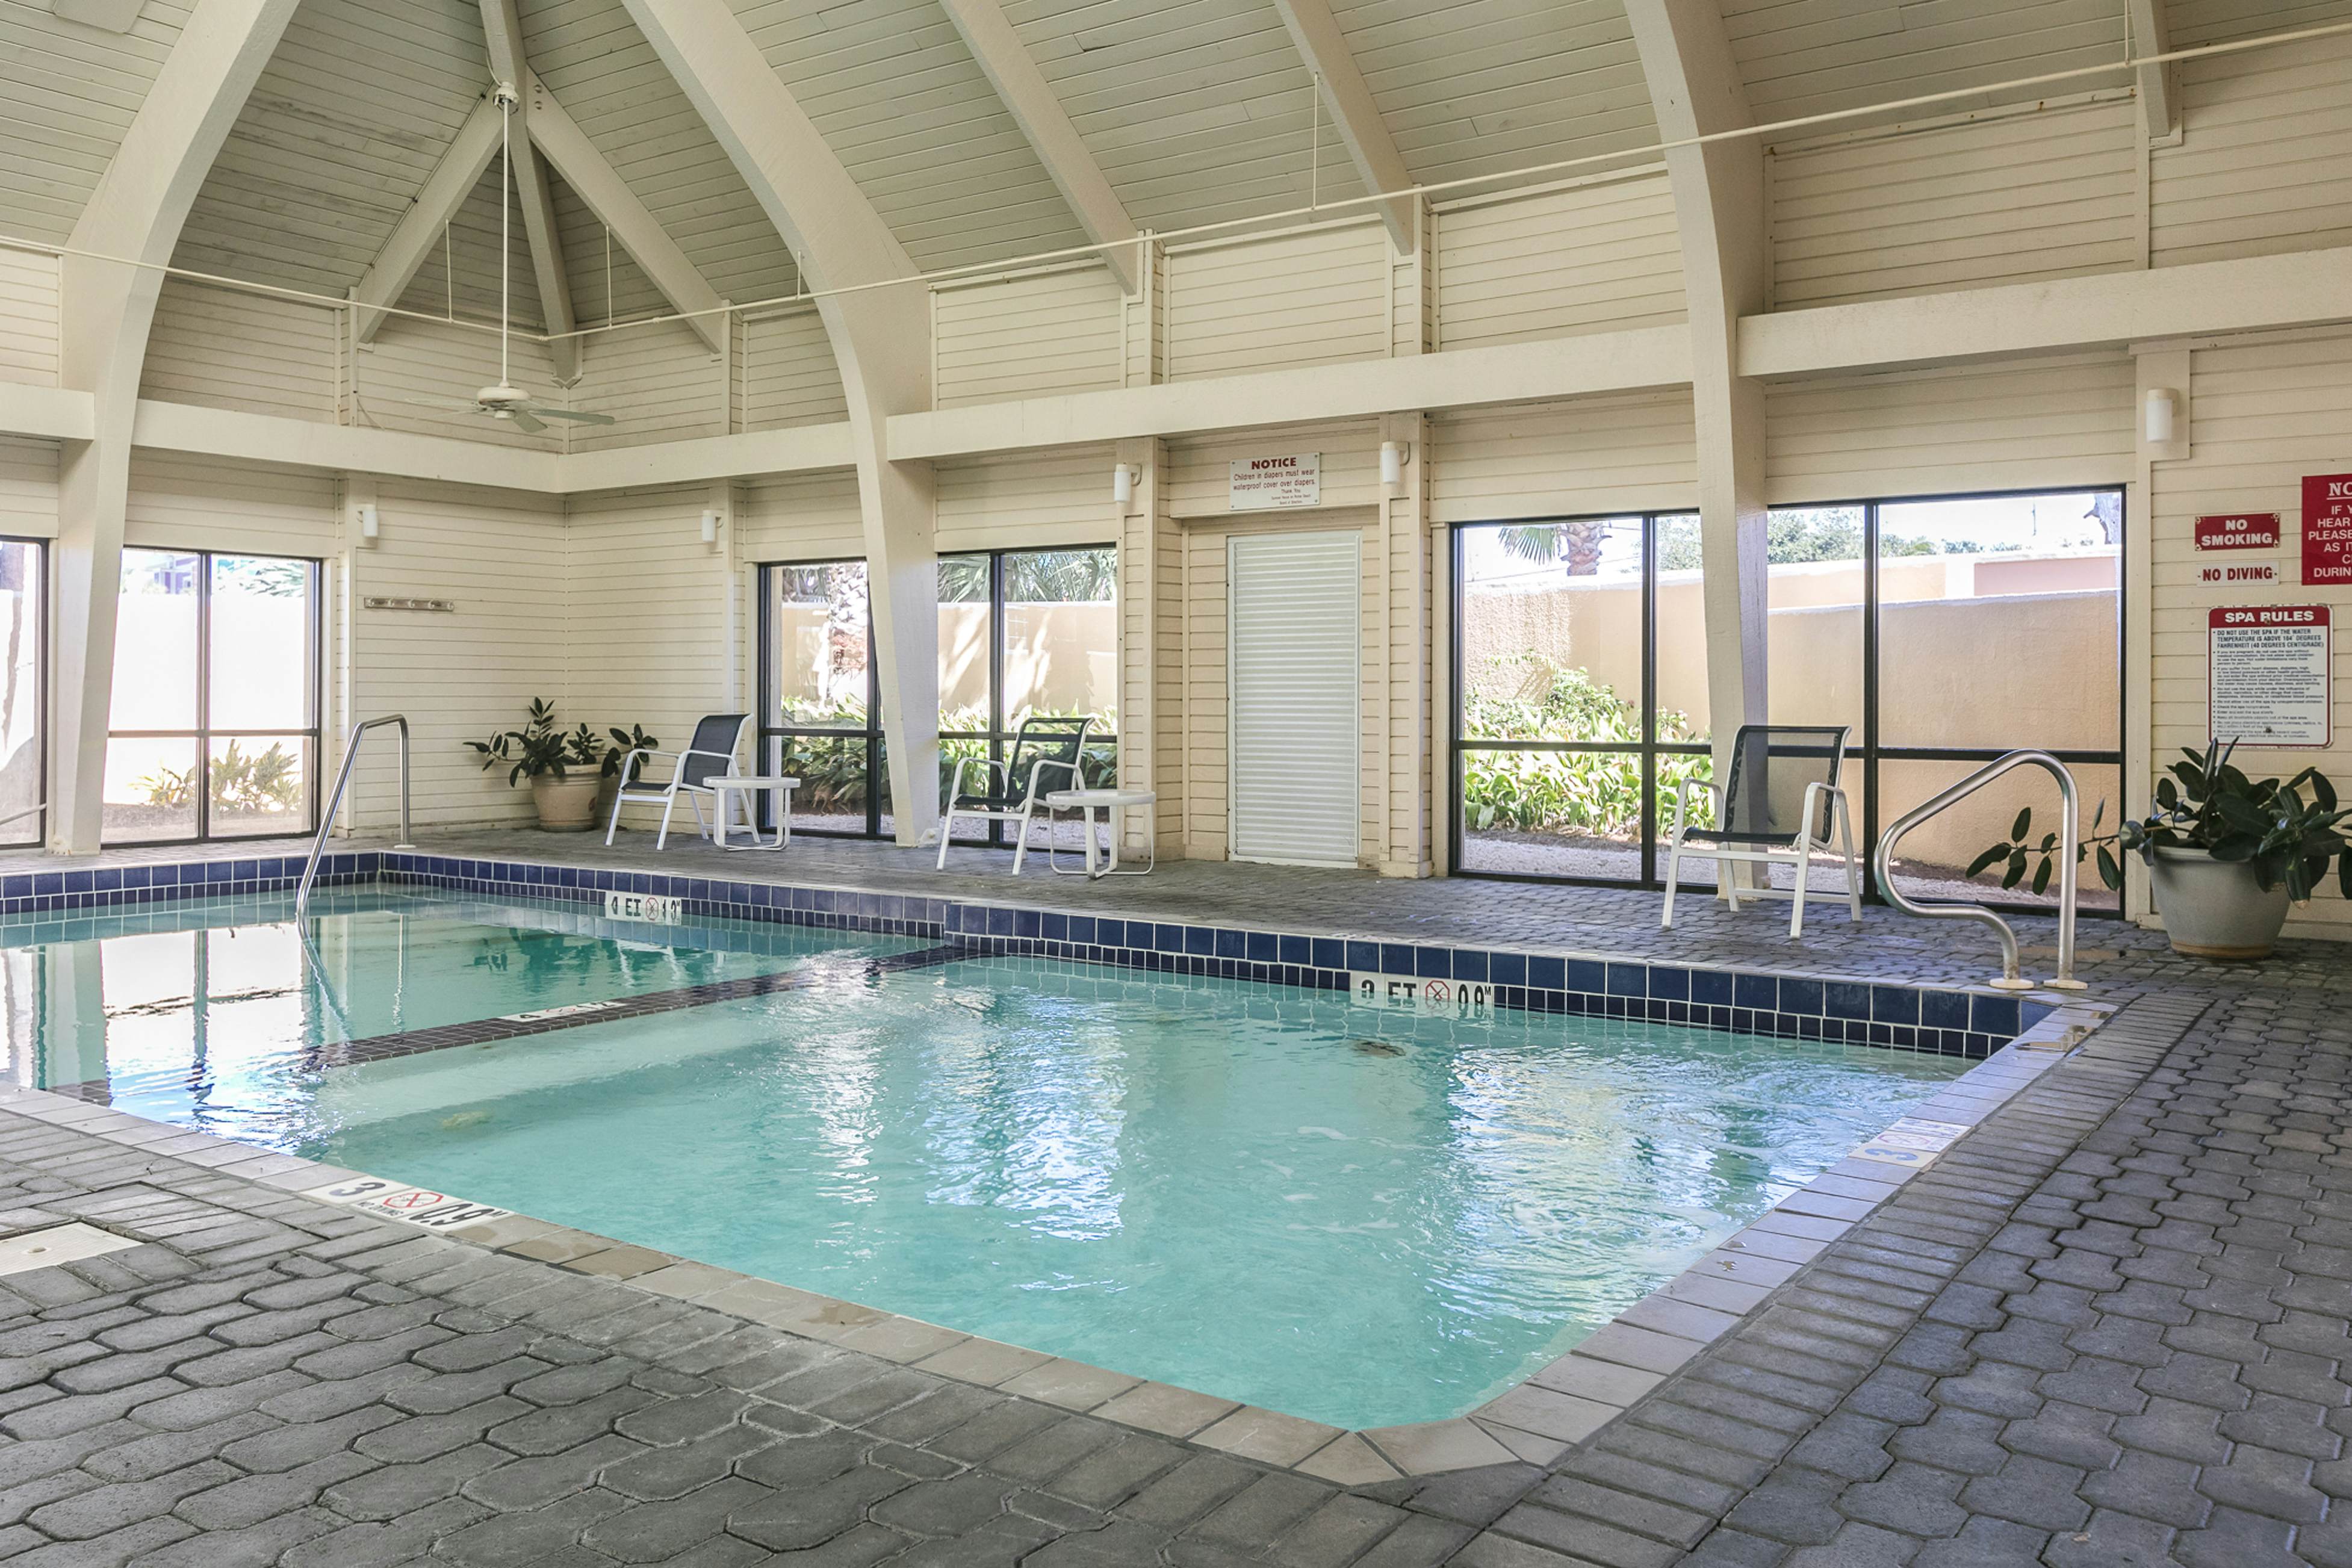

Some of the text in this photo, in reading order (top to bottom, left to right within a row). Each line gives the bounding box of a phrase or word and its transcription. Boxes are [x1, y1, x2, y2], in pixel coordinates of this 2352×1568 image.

[1252, 457, 1296, 469] NOTICE
[1264, 471, 1283, 480] diapers
[2332, 506, 2342, 514] IF
[2226, 519, 2247, 530] NO
[2318, 517, 2350, 528] HEAR
[2201, 533, 2273, 546] SMOKING
[2324, 543, 2340, 552] AS
[2203, 566, 2273, 581] NO DIVING
[2225, 610, 2314, 623] SPA RULES
[329, 1182, 386, 1197] 3
